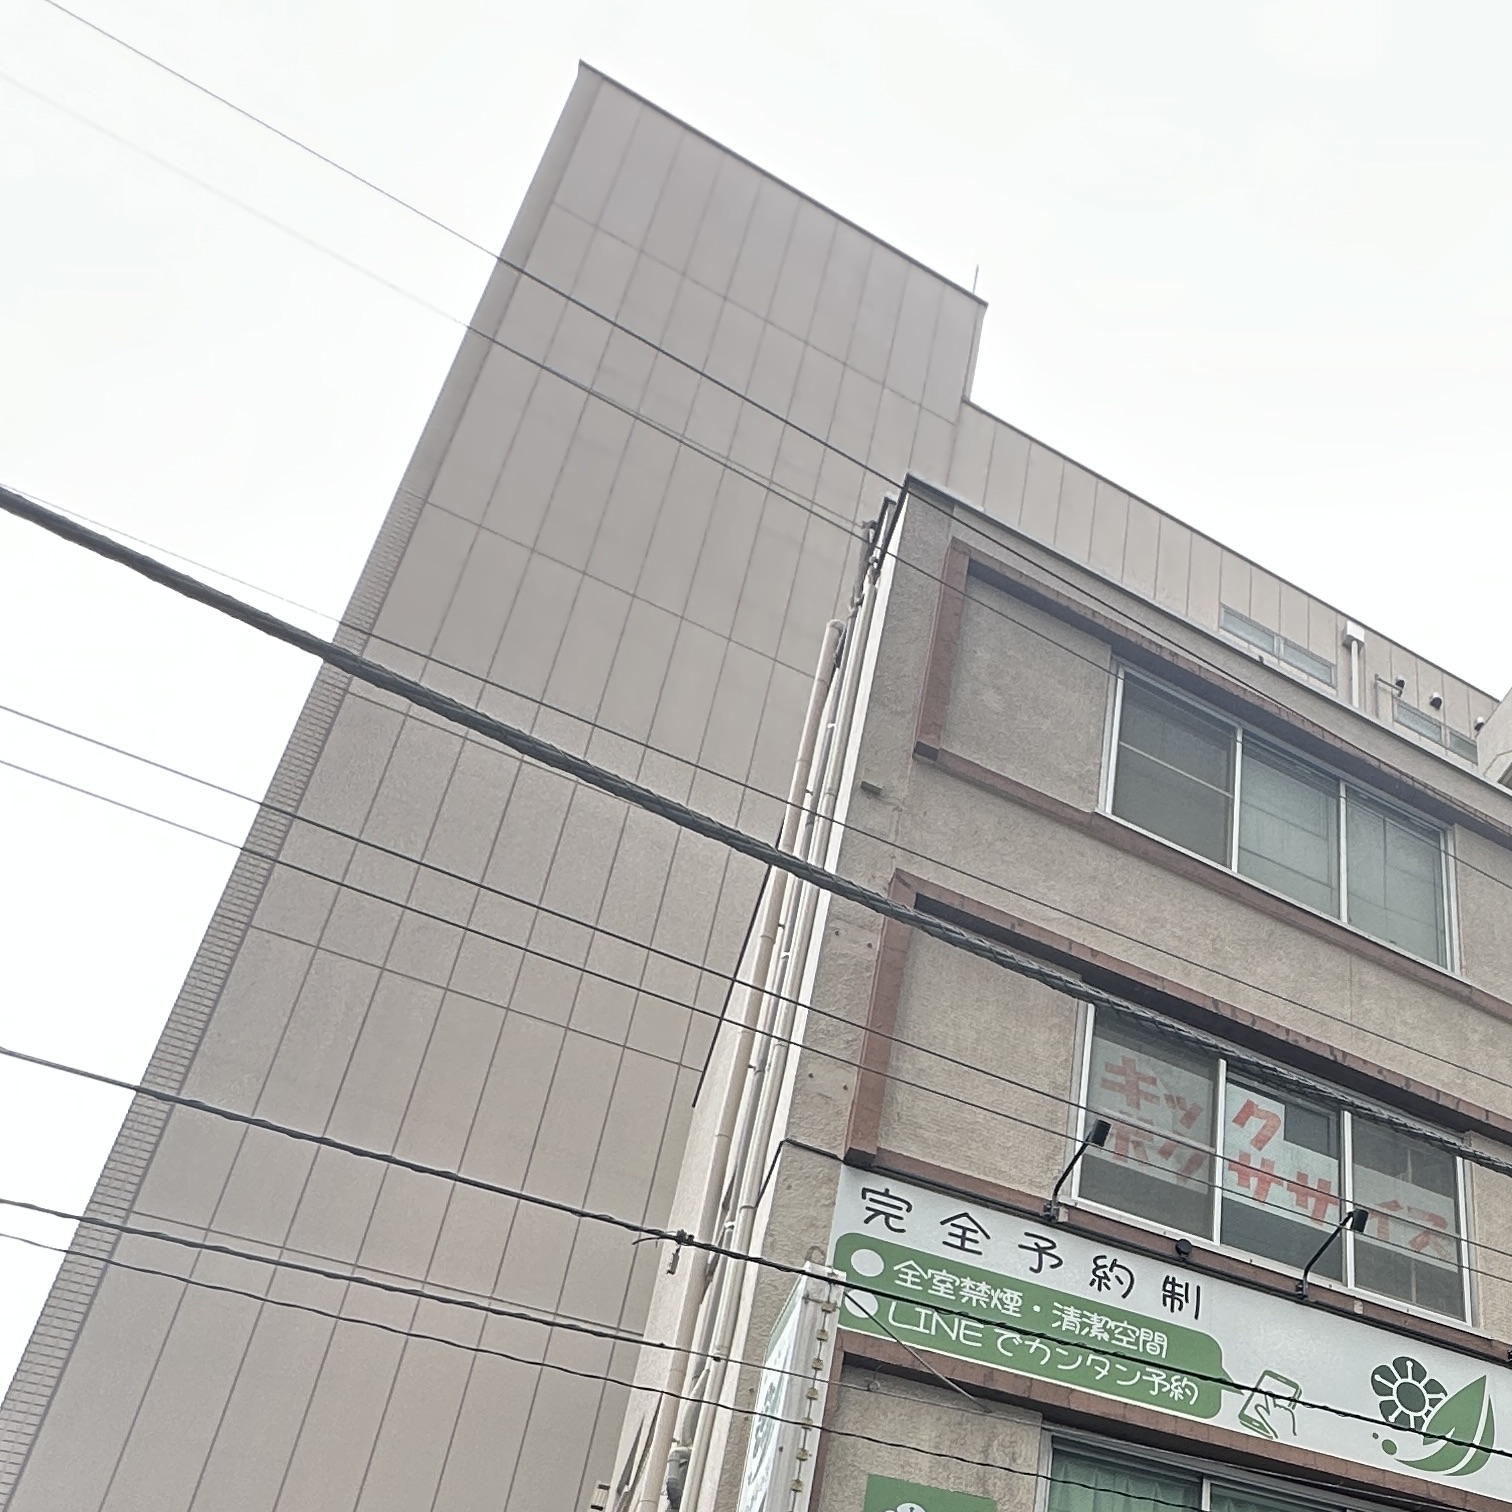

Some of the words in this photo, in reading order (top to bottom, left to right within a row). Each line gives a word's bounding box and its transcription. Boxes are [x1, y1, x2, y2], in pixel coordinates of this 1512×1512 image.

[861, 1187, 1201, 1320] 完全予約制
[893, 1260, 1168, 1359] 全室禁煙・清潔空間
